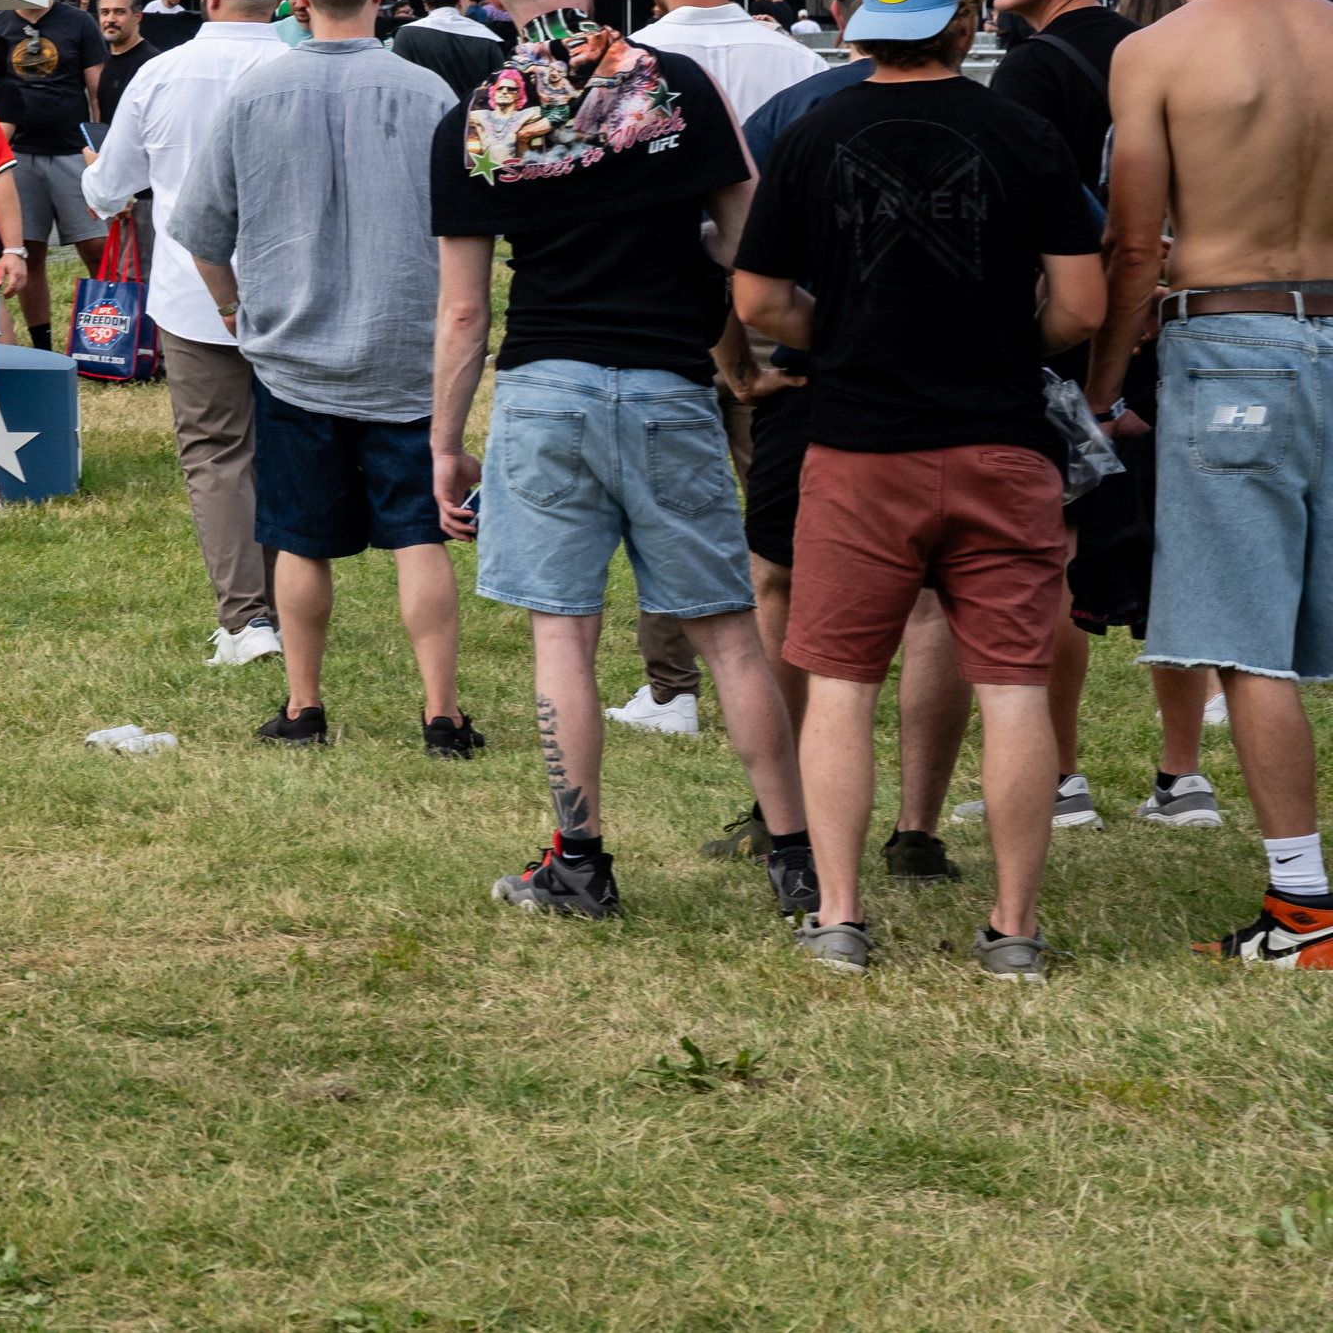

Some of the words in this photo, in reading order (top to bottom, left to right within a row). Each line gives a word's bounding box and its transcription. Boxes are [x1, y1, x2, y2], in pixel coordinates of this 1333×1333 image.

[499, 157, 575, 183] Sweet
[581, 147, 605, 168] to
[607, 106, 687, 154] Watch
[648, 133, 680, 154] UFC
[89, 327, 114, 342] 250
